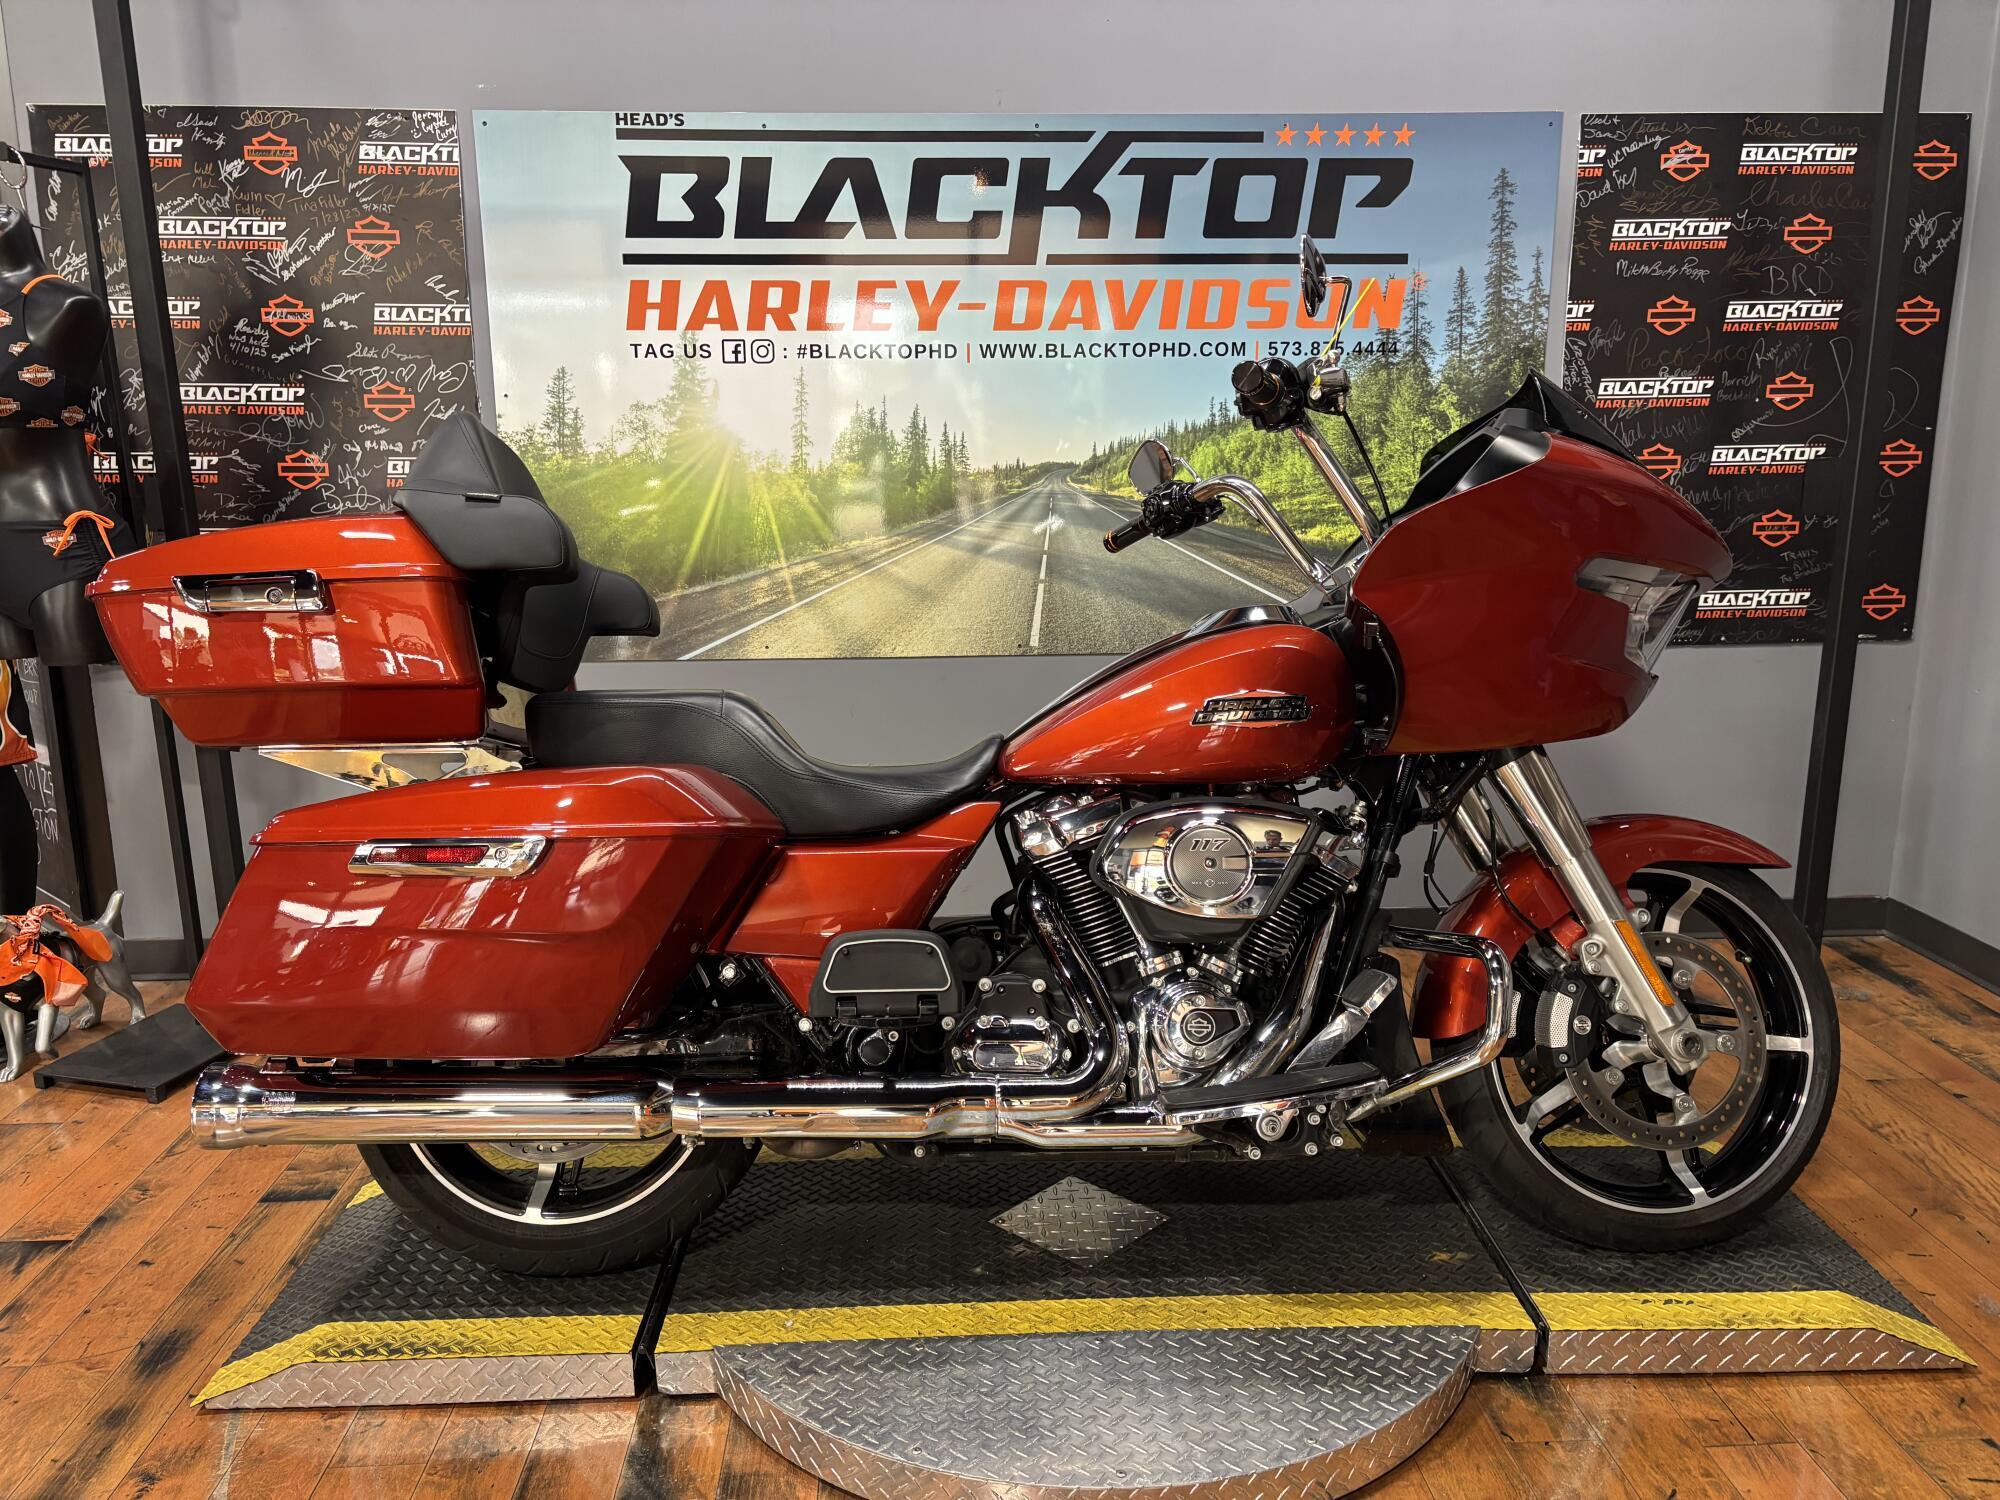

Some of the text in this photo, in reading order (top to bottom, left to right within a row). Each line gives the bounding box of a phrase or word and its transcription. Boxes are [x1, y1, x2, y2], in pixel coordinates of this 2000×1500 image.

[615, 111, 685, 127] HEAD'S
[1740, 144, 1858, 165] BLACKTOP
[1737, 165, 1855, 176] HARLEY-DAVIDSON
[617, 131, 1414, 265] BLACKTOP
[158, 217, 287, 238] BLACKTOP
[1612, 219, 1732, 240] BLACKTOP
[159, 239, 287, 250] HARLEY-DAVIDSON
[1609, 240, 1728, 251] HARLEY-DAVIDSON
[626, 278, 1408, 331] HARLEY-DAVIDSON
[1725, 301, 1843, 321] BLACKTOP
[1722, 322, 1839, 332] HARLEY-DAVIDSON
[630, 343, 675, 360] TAG
[683, 343, 712, 360] US
[797, 343, 958, 360] #BLACKTOPHD
[979, 341, 1247, 359] WWW.BLACKTOPHD.COM
[180, 384, 305, 405] BLACKTOP
[1598, 377, 1715, 397] BLACKTOP
[1595, 398, 1711, 409] HARLEY-DAVIDSON
[1710, 444, 1826, 465] BLACKTOP
[1698, 589, 1811, 608] BLACKTOP
[1695, 608, 1807, 619] HARLEY-DAVIDSON
[1190, 838, 1231, 851] 117
